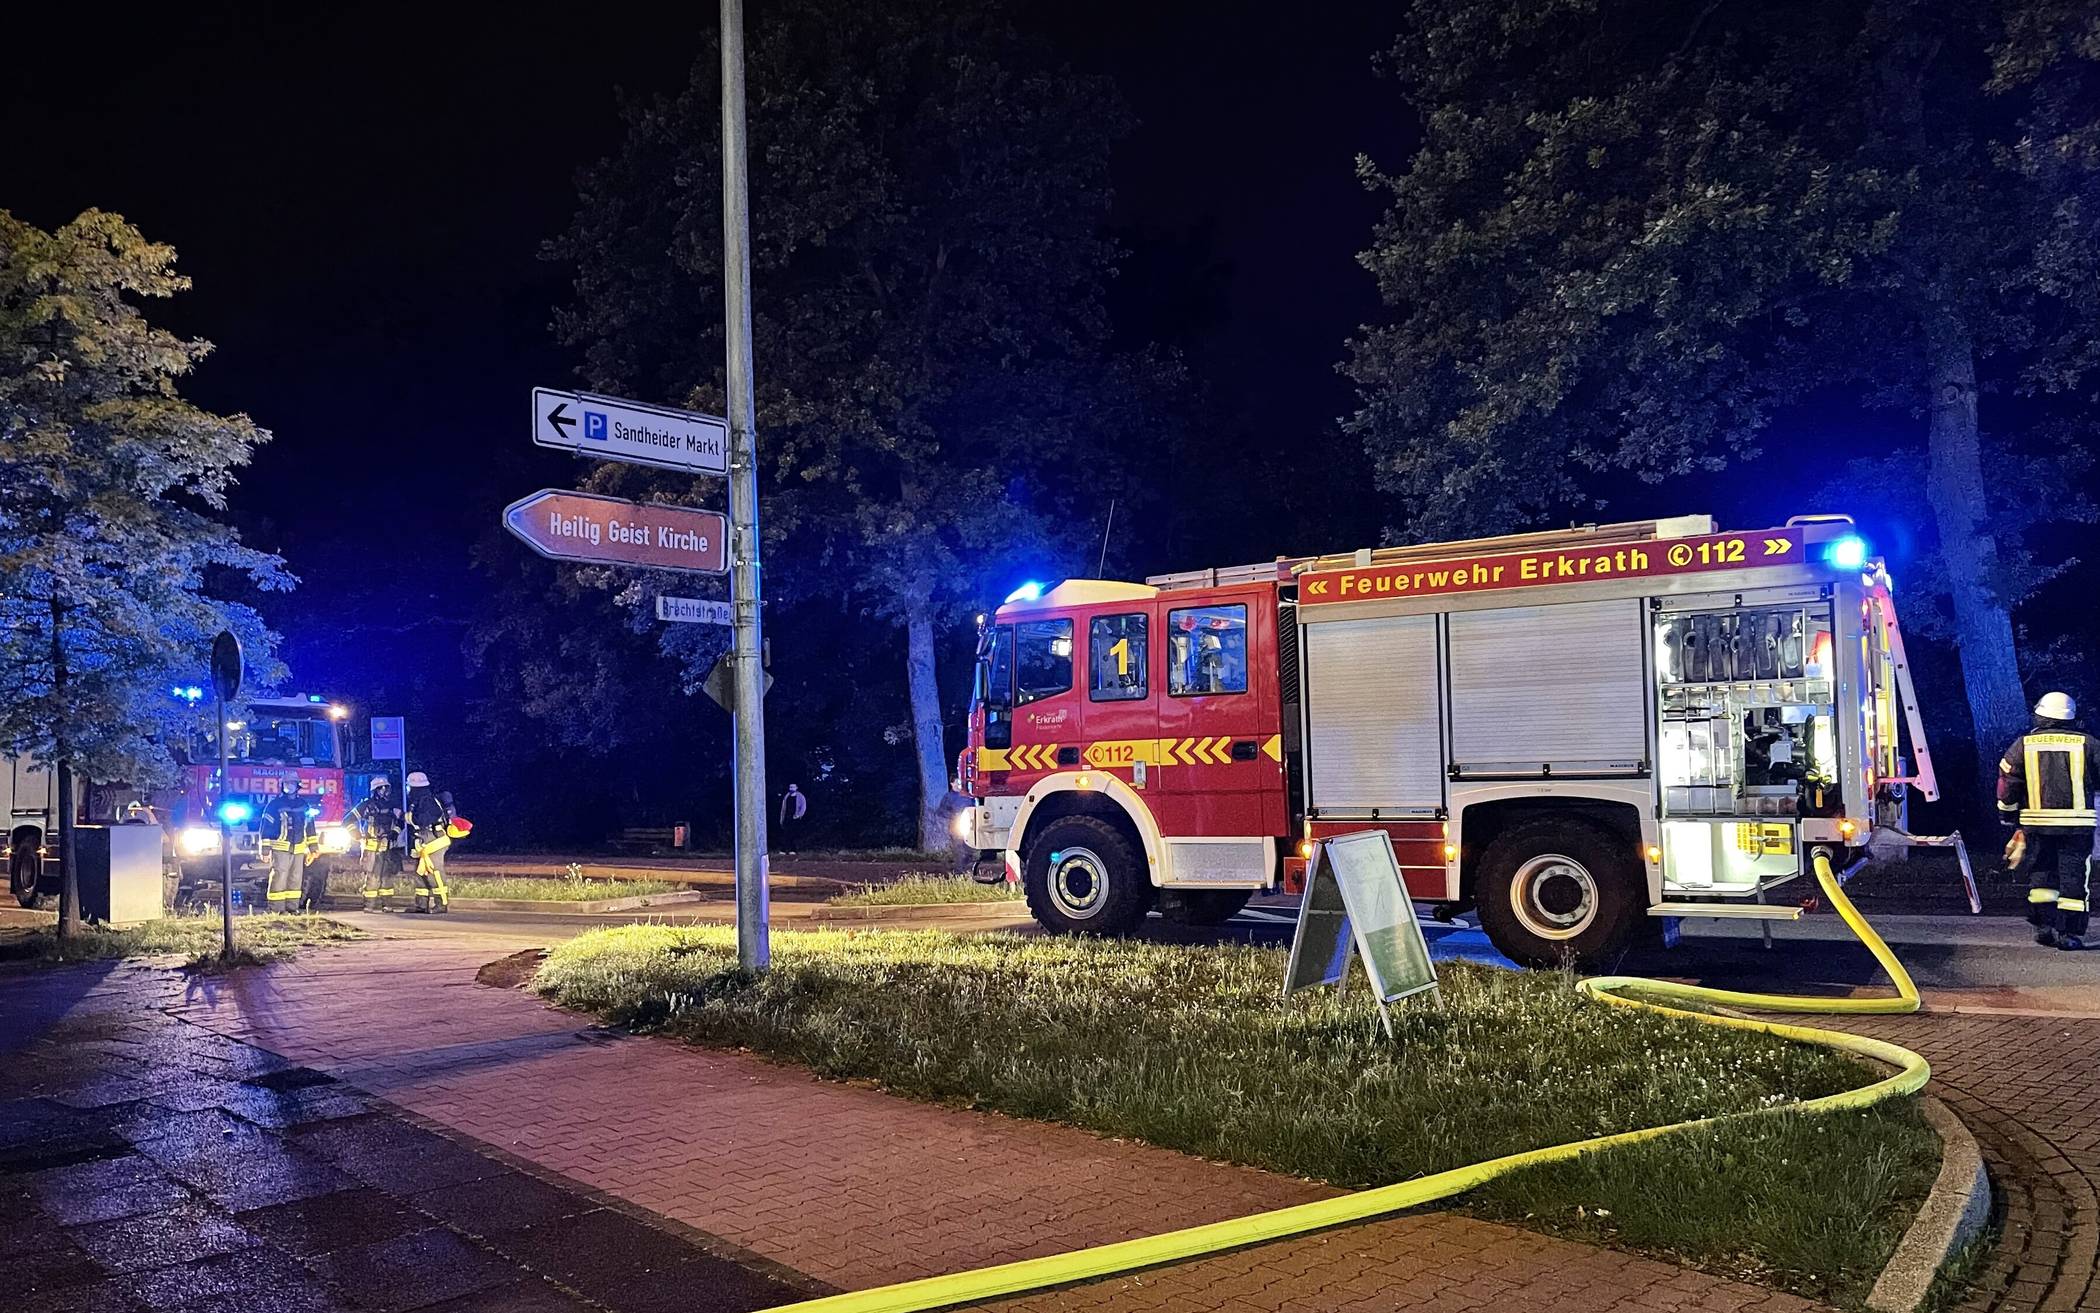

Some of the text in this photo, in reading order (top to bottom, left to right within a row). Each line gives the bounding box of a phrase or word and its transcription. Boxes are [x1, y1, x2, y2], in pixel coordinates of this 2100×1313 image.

[589, 415, 719, 456] P Sandheider Markt
[550, 511, 708, 552] Heilig Geist Kirche
[1339, 539, 1746, 595] Feuerwehr Erkrath 112
[662, 597, 729, 620] Brechtstraße
[1110, 638, 1128, 675] 1
[1105, 745, 1134, 762] 112
[2025, 735, 2082, 744] FEUERWEHR
